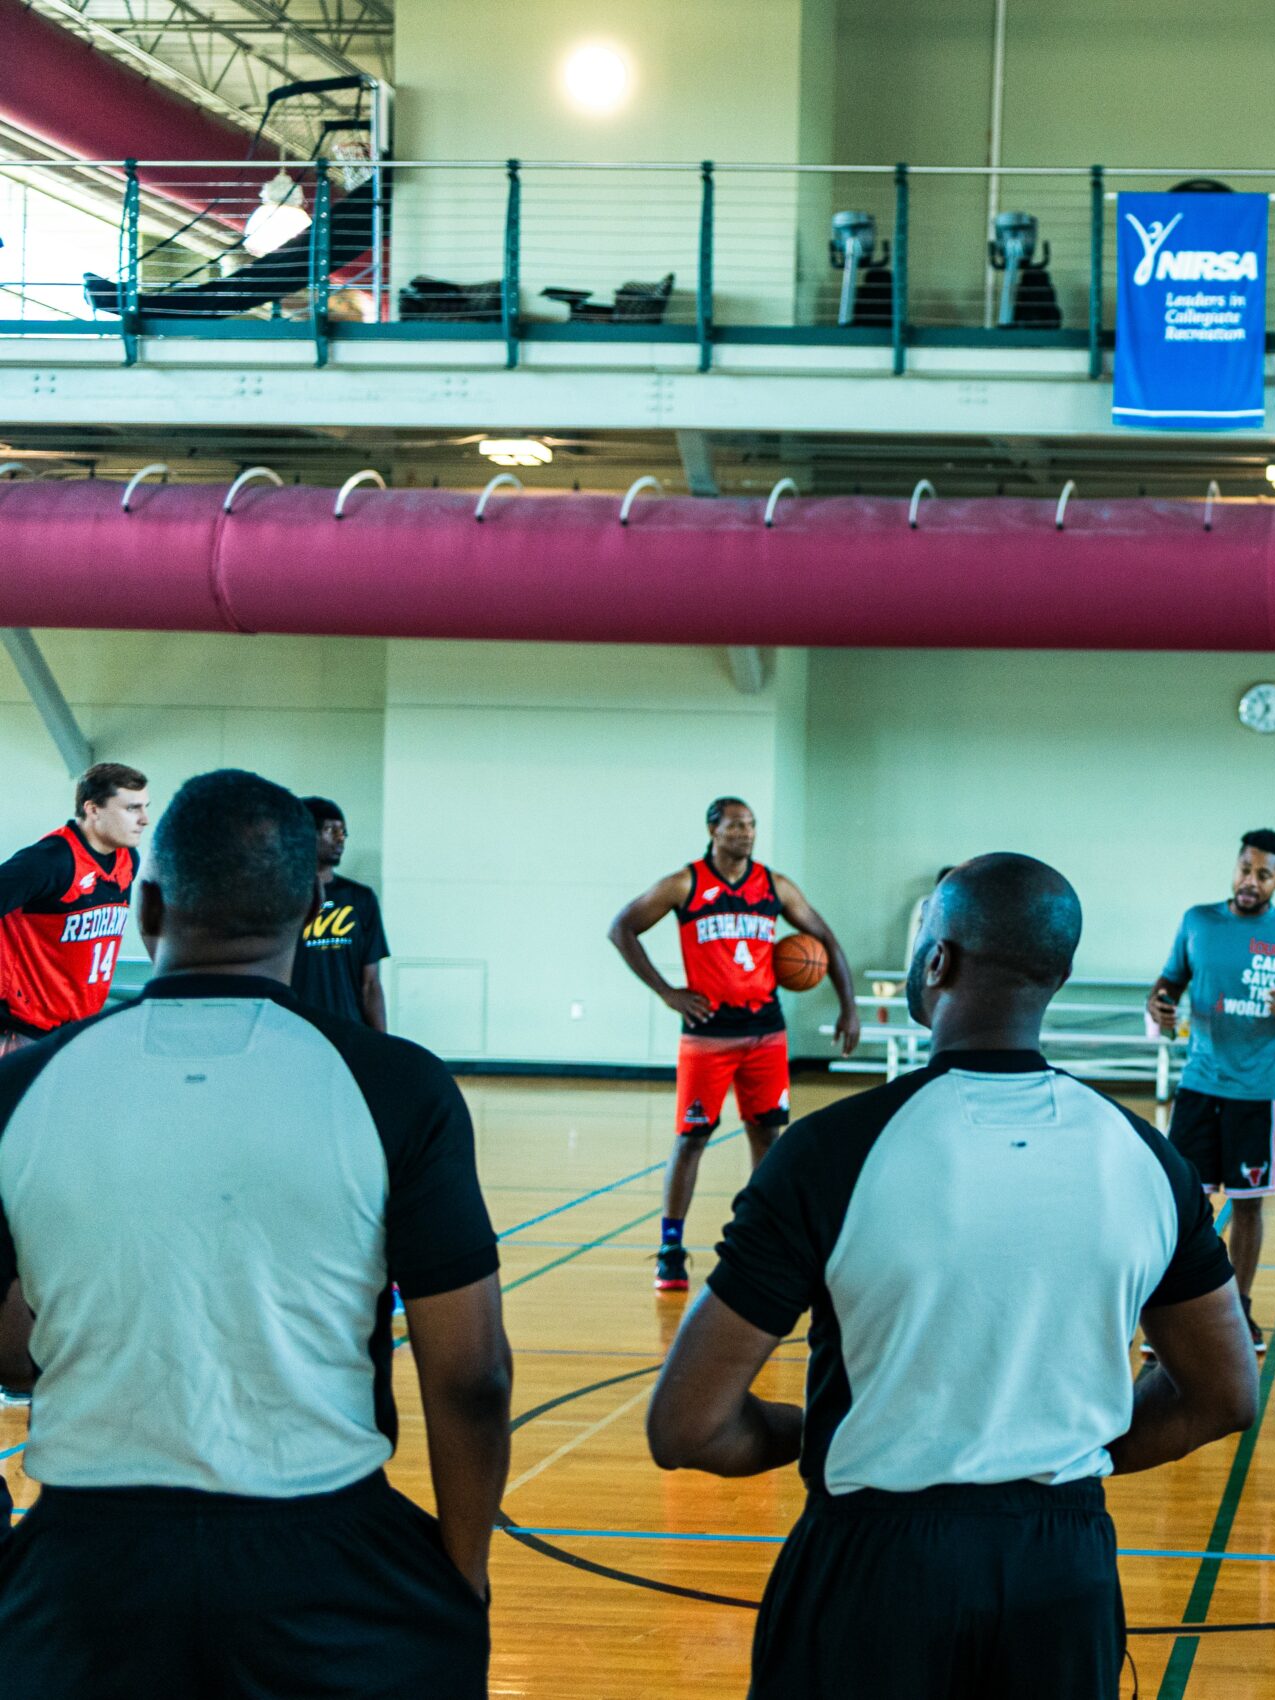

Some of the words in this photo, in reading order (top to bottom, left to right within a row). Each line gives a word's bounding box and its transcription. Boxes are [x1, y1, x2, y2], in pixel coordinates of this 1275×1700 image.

[1155, 251, 1258, 281] NIRSA
[1165, 292, 1225, 307] Leaders
[1229, 292, 1246, 307] in
[1165, 309, 1240, 327] Collegiate
[1165, 326, 1246, 341] Recreation
[87, 940, 116, 984] 14
[733, 940, 755, 972] 4
